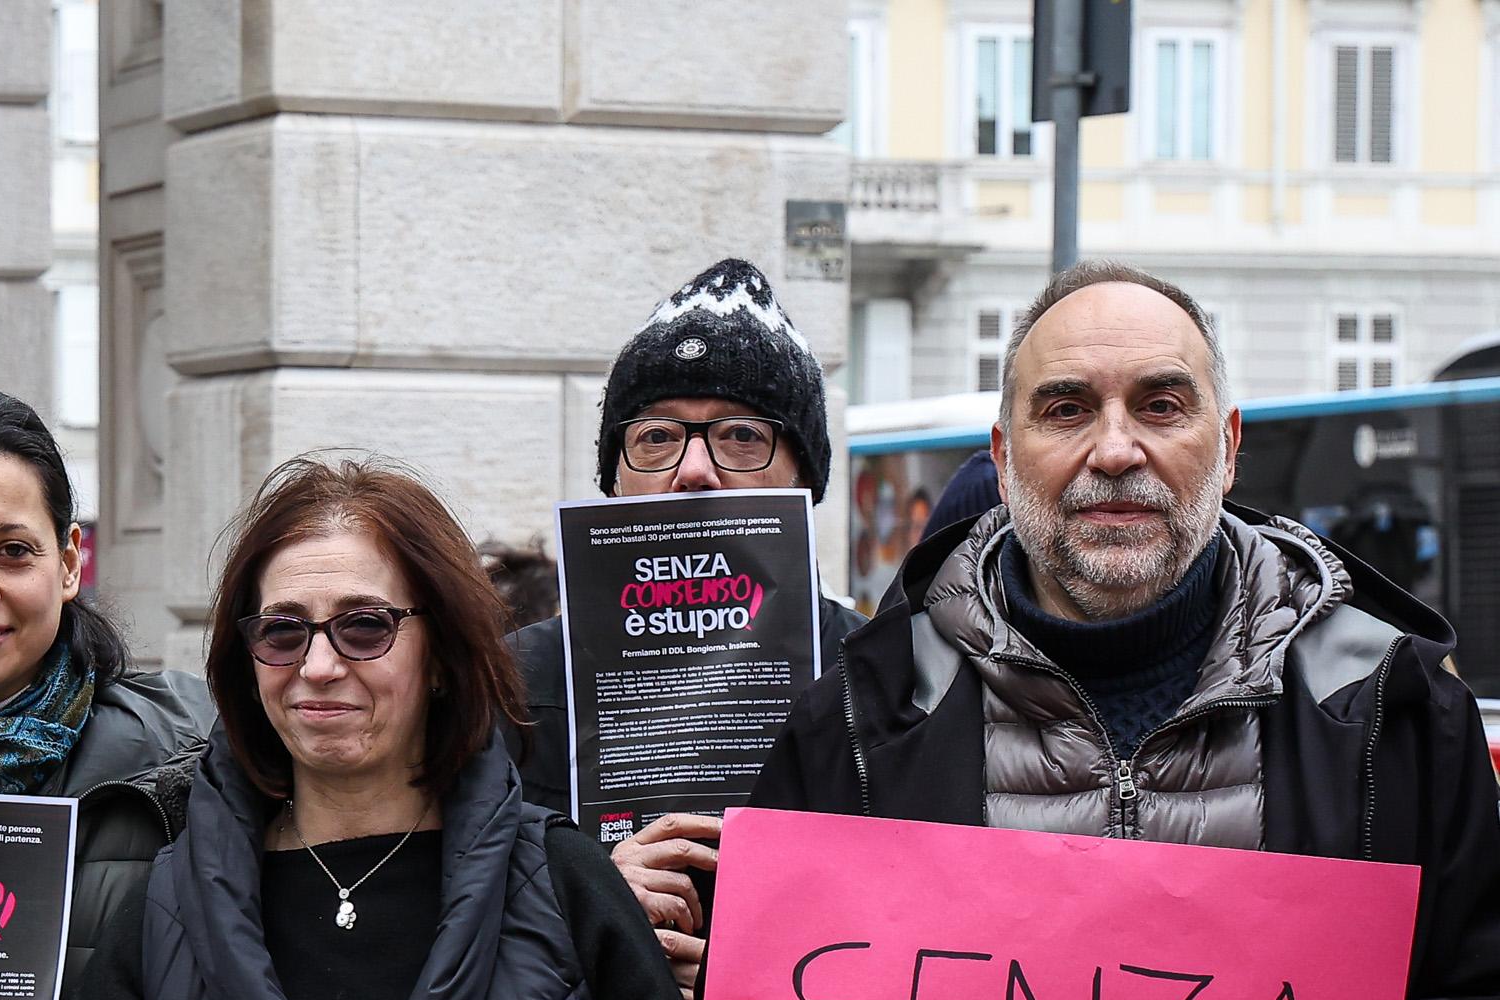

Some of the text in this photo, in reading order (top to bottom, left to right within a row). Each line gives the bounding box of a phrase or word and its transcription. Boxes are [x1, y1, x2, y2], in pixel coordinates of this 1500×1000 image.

[589, 516, 782, 536] Sono serviti 50 anni per essere considerate persone.
[590, 525, 782, 545] Ne sono bastati 30 per tornare al punto di partenza.
[635, 552, 731, 583] SENZA
[620, 574, 751, 610] CONSENSO
[625, 612, 645, 637] è
[622, 640, 760, 658] Fermiamo il DDL Bongiorno. Insieme.
[7, 824, 43, 834] persone.
[600, 819, 633, 831] scelta
[4, 834, 42, 844] partenza.
